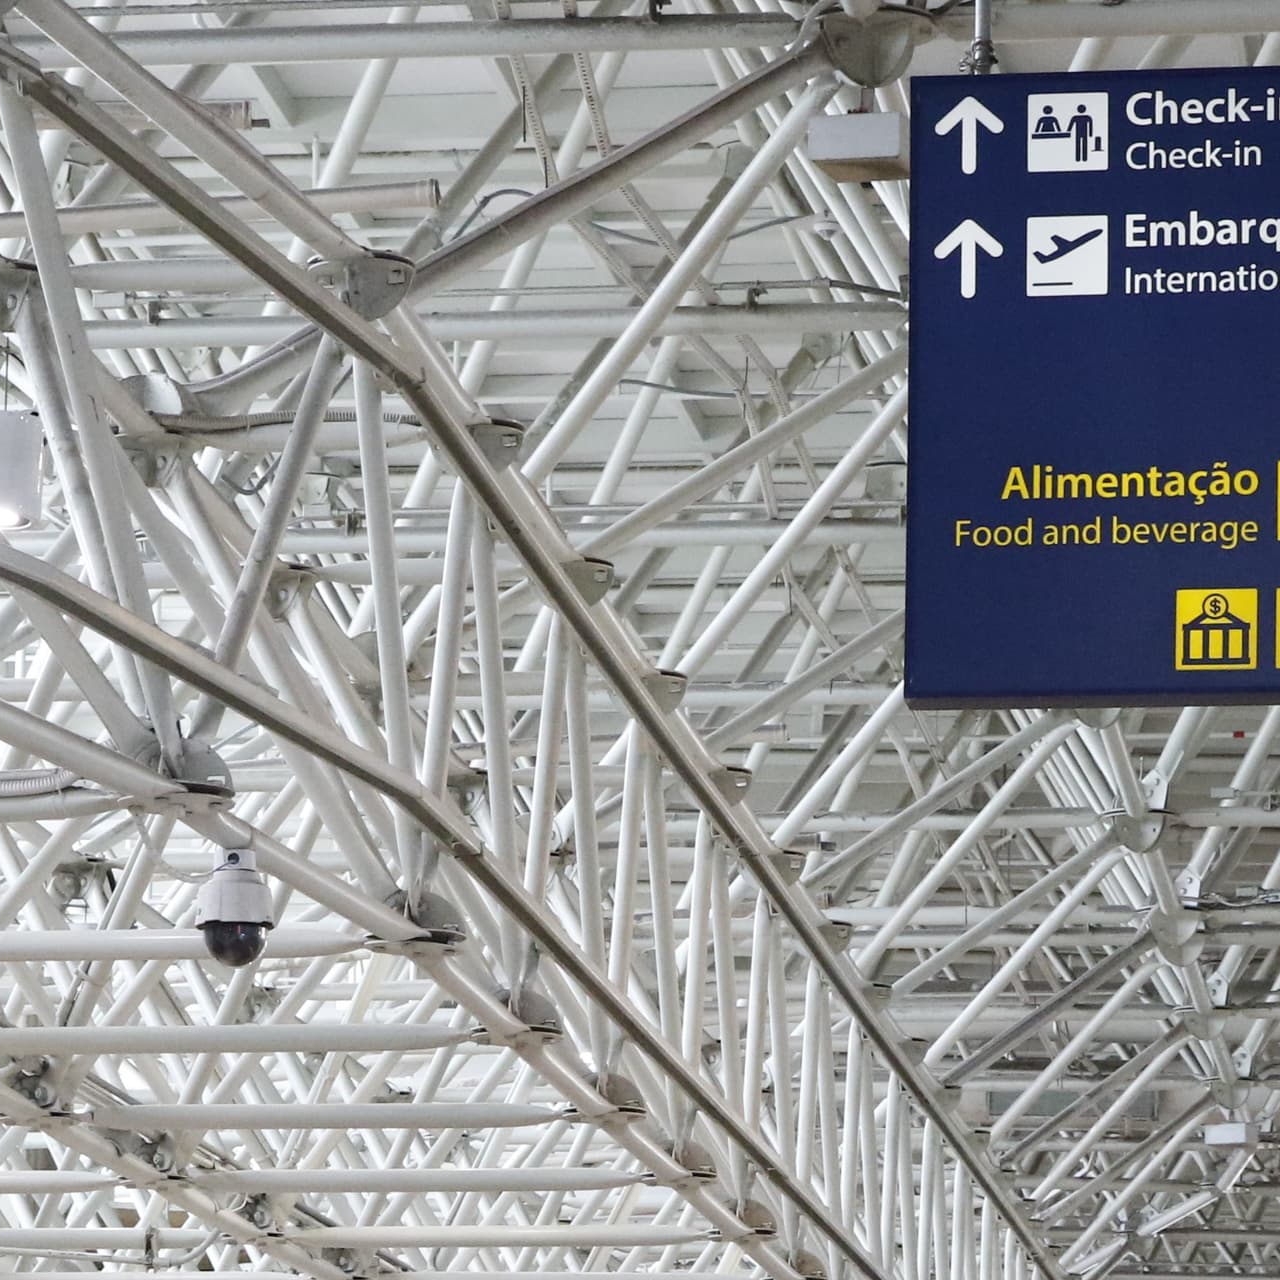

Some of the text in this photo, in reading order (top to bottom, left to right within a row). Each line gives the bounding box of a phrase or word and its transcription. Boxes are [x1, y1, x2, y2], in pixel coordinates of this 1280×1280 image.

[1125, 139, 1262, 170] Check-in
[1001, 460, 1259, 506] Alimentação
[955, 515, 1259, 550] Food and beverage
